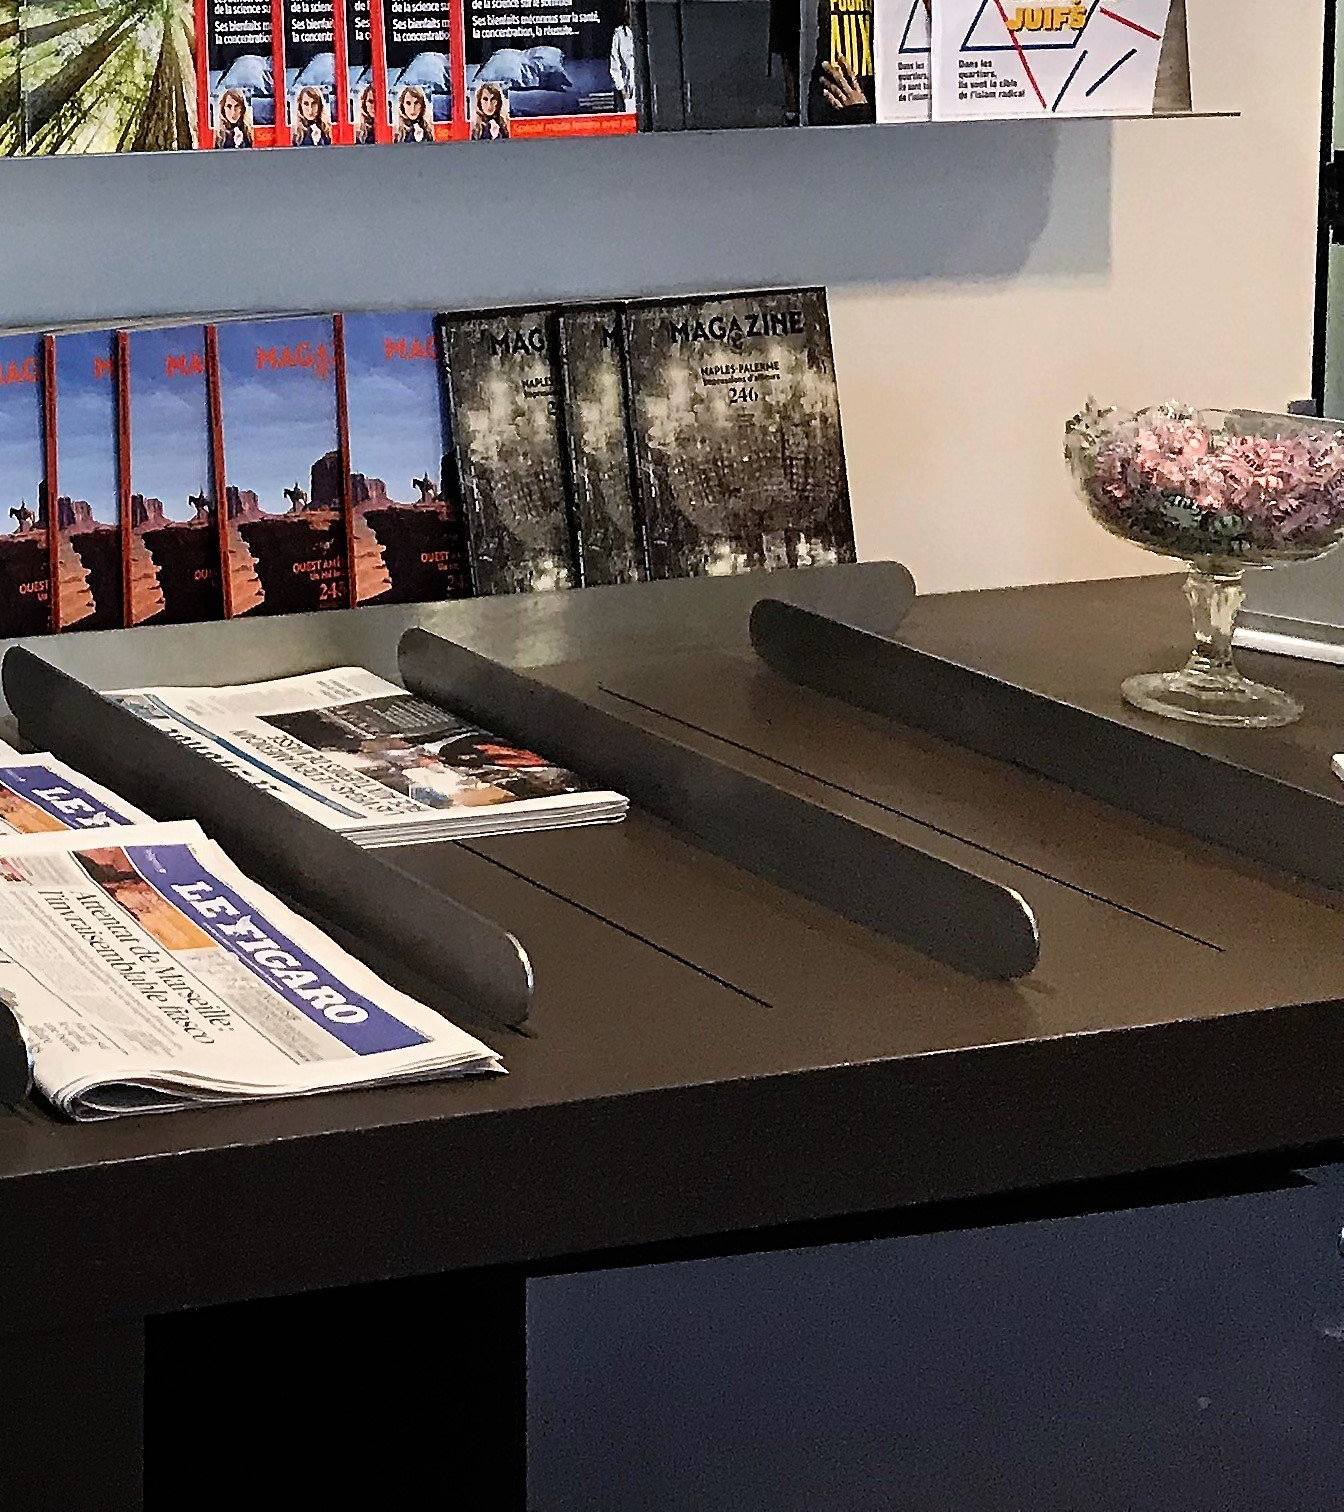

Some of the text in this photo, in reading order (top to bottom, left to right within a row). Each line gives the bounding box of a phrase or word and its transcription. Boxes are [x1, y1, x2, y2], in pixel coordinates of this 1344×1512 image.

[1006, 4, 1086, 31] JUIFS
[670, 309, 806, 350] MAGAZINE
[169, 880, 372, 1026] LE FIGARO
